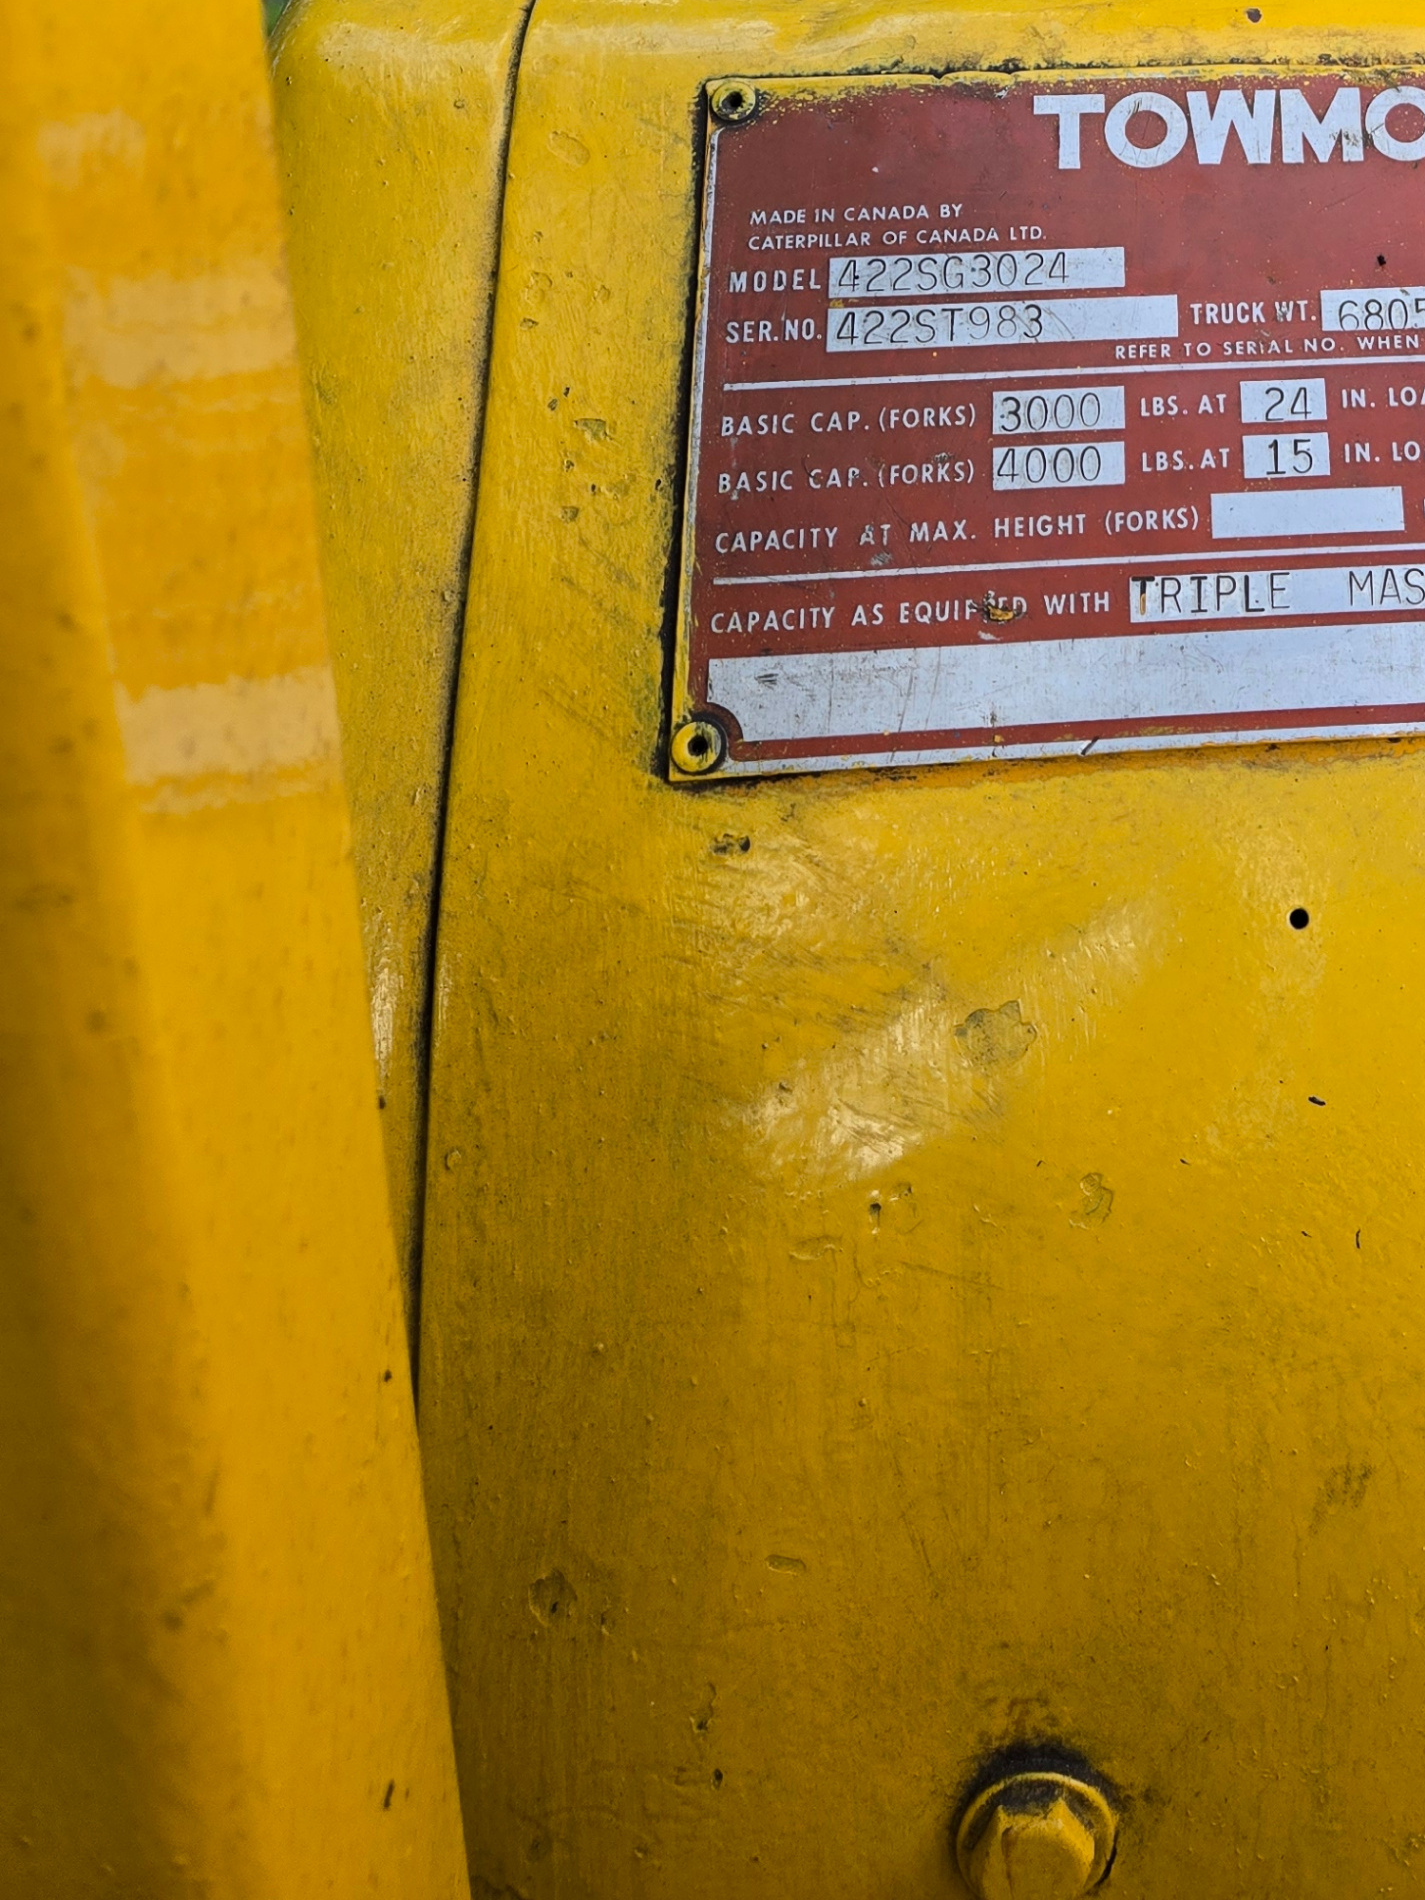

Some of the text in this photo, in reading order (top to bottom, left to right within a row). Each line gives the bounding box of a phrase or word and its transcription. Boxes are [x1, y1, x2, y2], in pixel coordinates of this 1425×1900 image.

[750, 204, 962, 225] MADE IN CANADA BY
[749, 226, 1046, 250] CATERPILLAR OF CANADA LTD.
[730, 252, 1069, 292] MODEL 422SG3024
[837, 305, 1042, 345] 422ST983
[1190, 302, 1265, 324] TRUCK
[1275, 300, 1316, 321] WT.
[1116, 344, 1170, 359] REFER
[1184, 343, 1211, 356] TO
[1224, 340, 1293, 355] SERIAL
[1304, 338, 1343, 352] NO.
[1357, 335, 1418, 349] WHEN
[722, 414, 794, 436] BASIC
[811, 412, 869, 432] CAP.
[880, 403, 975, 431] (FORKS)
[1001, 393, 1101, 432] 3000
[1141, 396, 1187, 416] LBS.
[1199, 394, 1226, 413] AT
[1265, 387, 1312, 421] 24
[1342, 389, 1375, 408] IN.
[719, 470, 792, 493] BASIC
[809, 468, 867, 488] CAP.
[879, 459, 974, 487] (FORKS)
[998, 446, 1101, 484] 4000
[1143, 450, 1193, 471] LBS.
[1201, 448, 1229, 469] AT
[1267, 439, 1313, 476] 15
[1345, 443, 1379, 462] IN.
[716, 527, 837, 553] CAPACITY
[860, 524, 890, 545] AT
[910, 520, 975, 542] MAX.
[995, 514, 1085, 537] HEIGHT
[1106, 506, 1198, 535] (FORKS)
[711, 607, 835, 633] CAPACITY
[852, 604, 883, 625] AS
[1044, 592, 1109, 615] WITH
[1132, 573, 1291, 617] TRIPLE
